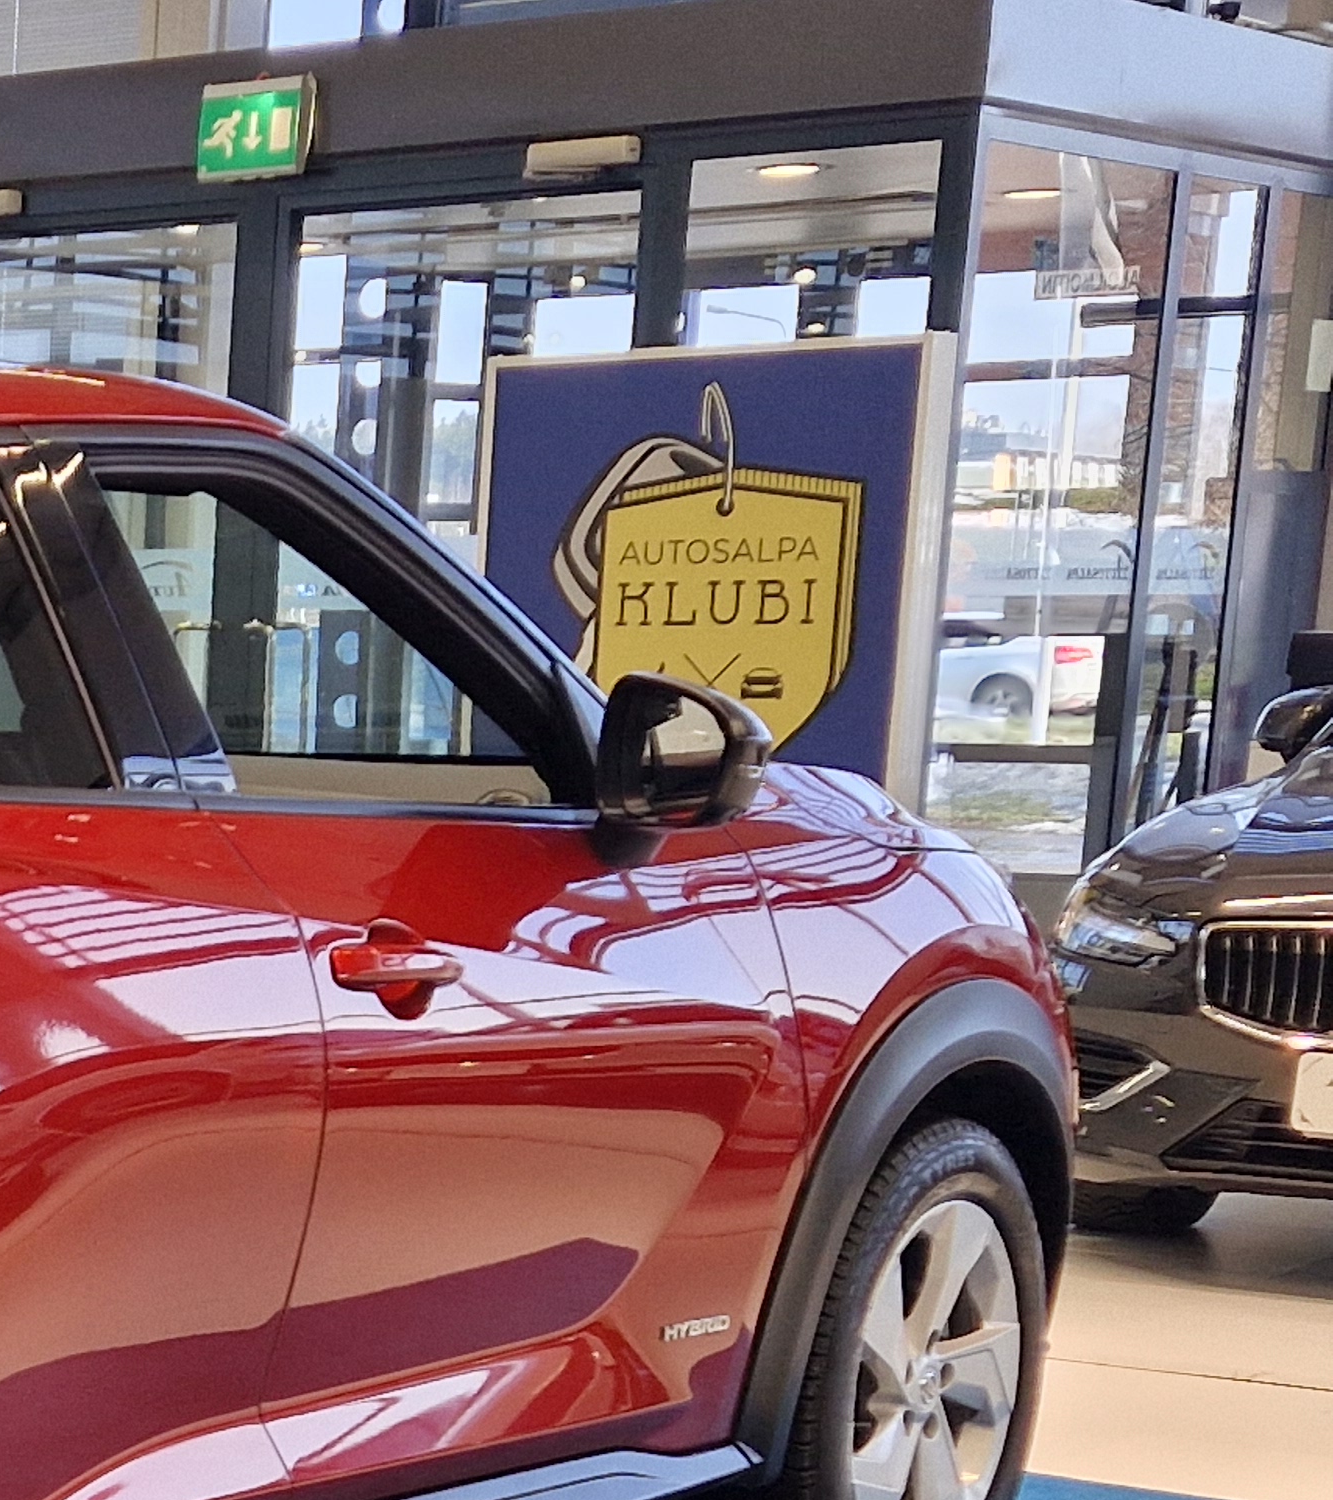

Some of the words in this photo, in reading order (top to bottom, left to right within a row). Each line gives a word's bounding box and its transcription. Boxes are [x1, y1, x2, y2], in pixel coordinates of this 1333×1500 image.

[618, 535, 820, 567] AUTOSALPA
[614, 577, 818, 627] KLUBI
[663, 1314, 731, 1343] HYBRID
